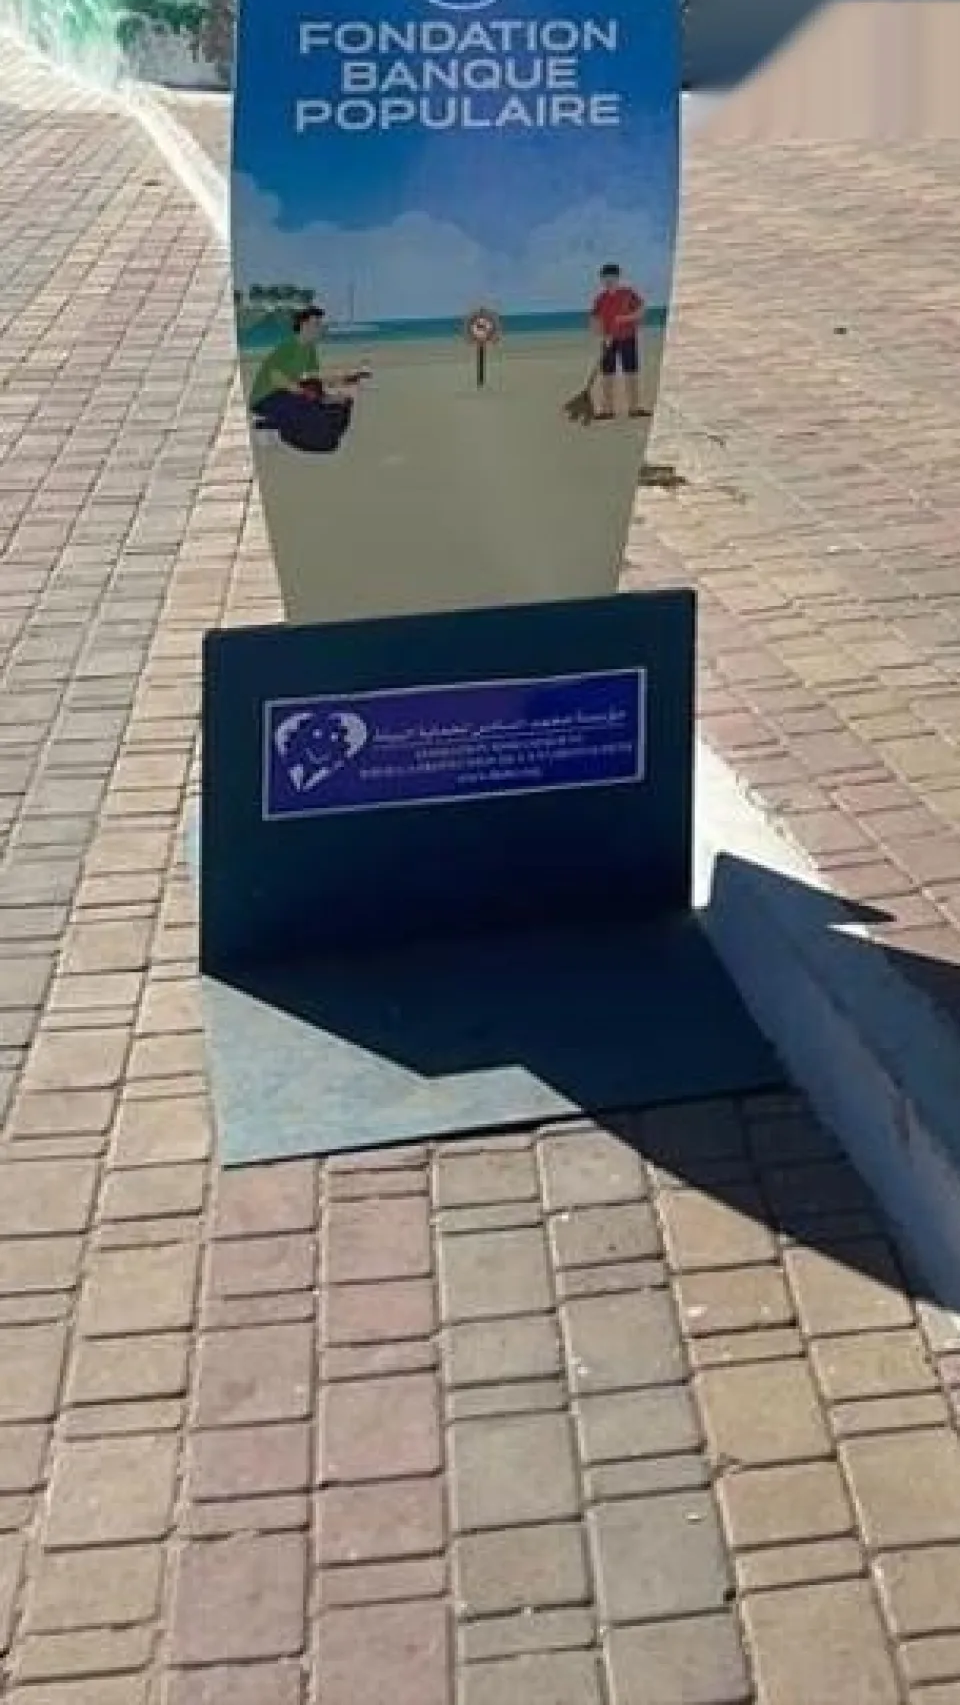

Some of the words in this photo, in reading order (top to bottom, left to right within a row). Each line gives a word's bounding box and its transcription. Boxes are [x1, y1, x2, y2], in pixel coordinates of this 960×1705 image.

[299, 19, 618, 54] FONDATION
[341, 56, 579, 92] BANQUE
[296, 93, 623, 133] POPULAIRE
